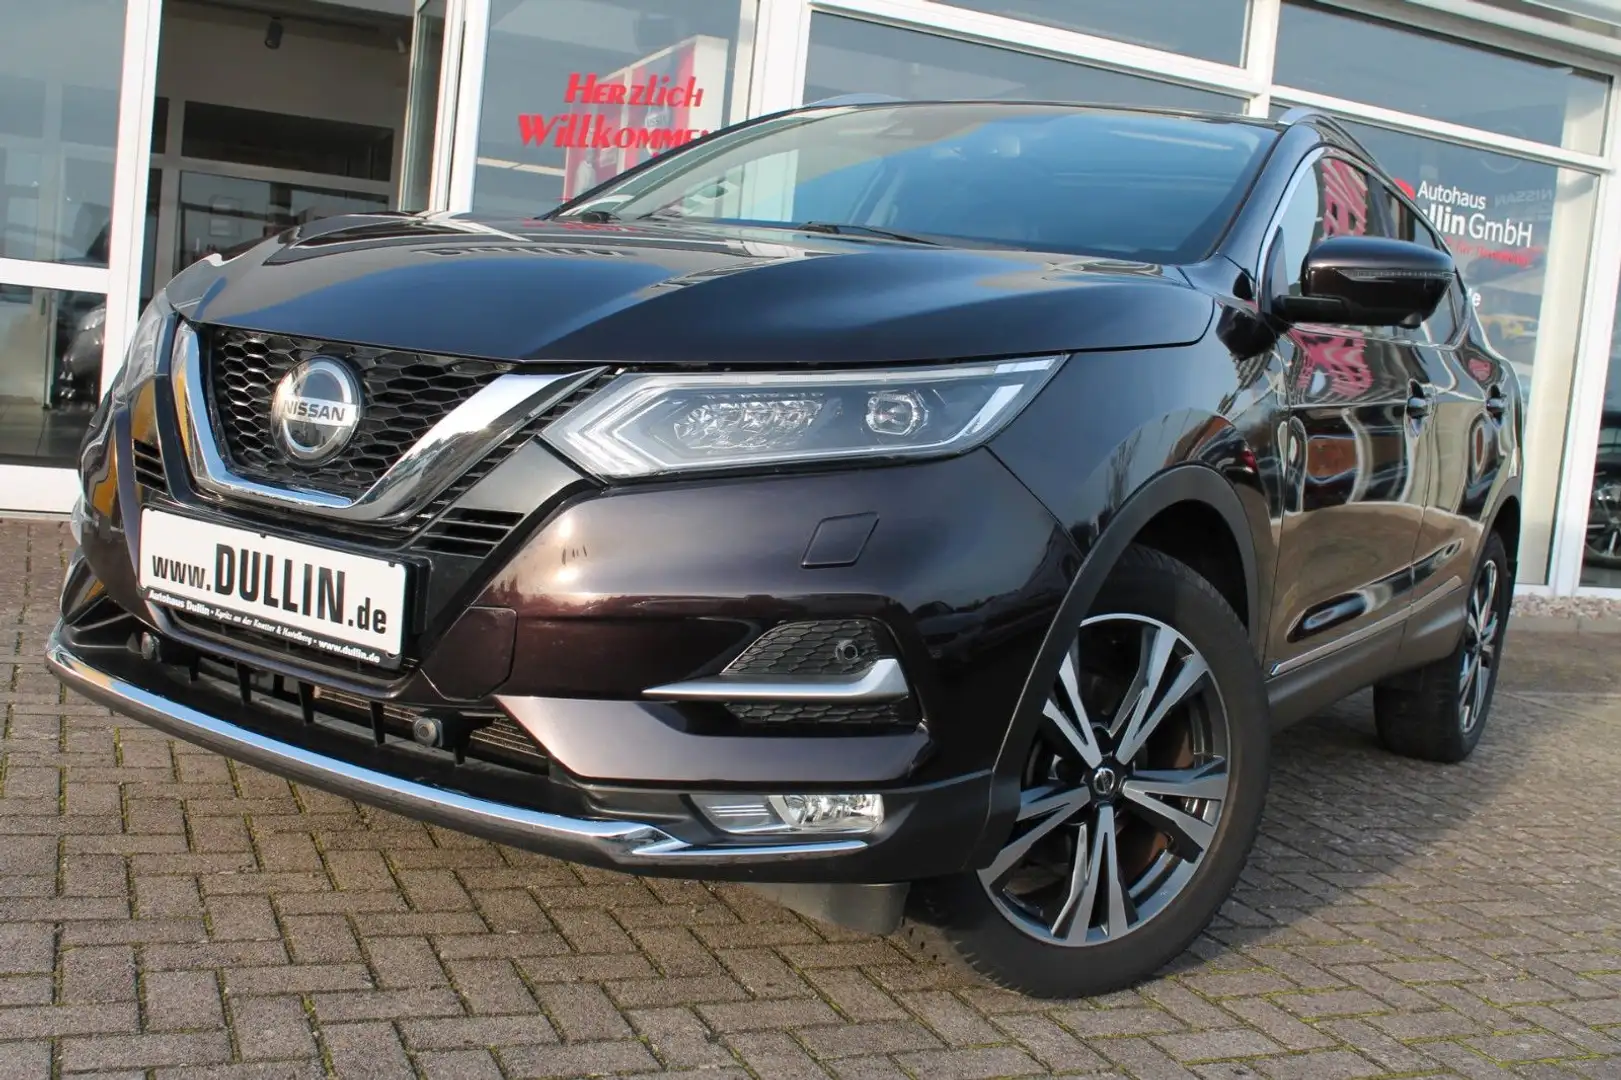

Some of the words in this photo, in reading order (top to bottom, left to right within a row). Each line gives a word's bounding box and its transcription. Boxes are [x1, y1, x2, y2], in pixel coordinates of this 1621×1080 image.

[1417, 180, 1486, 210] Autohaus
[1422, 203, 1465, 236] llin
[1468, 213, 1533, 248] GmbH
[283, 400, 346, 422] NISSAN
[152, 543, 387, 635] www.DULLIN.de
[149, 589, 185, 609] Autohaus
[186, 600, 210, 617] Dullin
[318, 639, 380, 663] www.dullin.de
